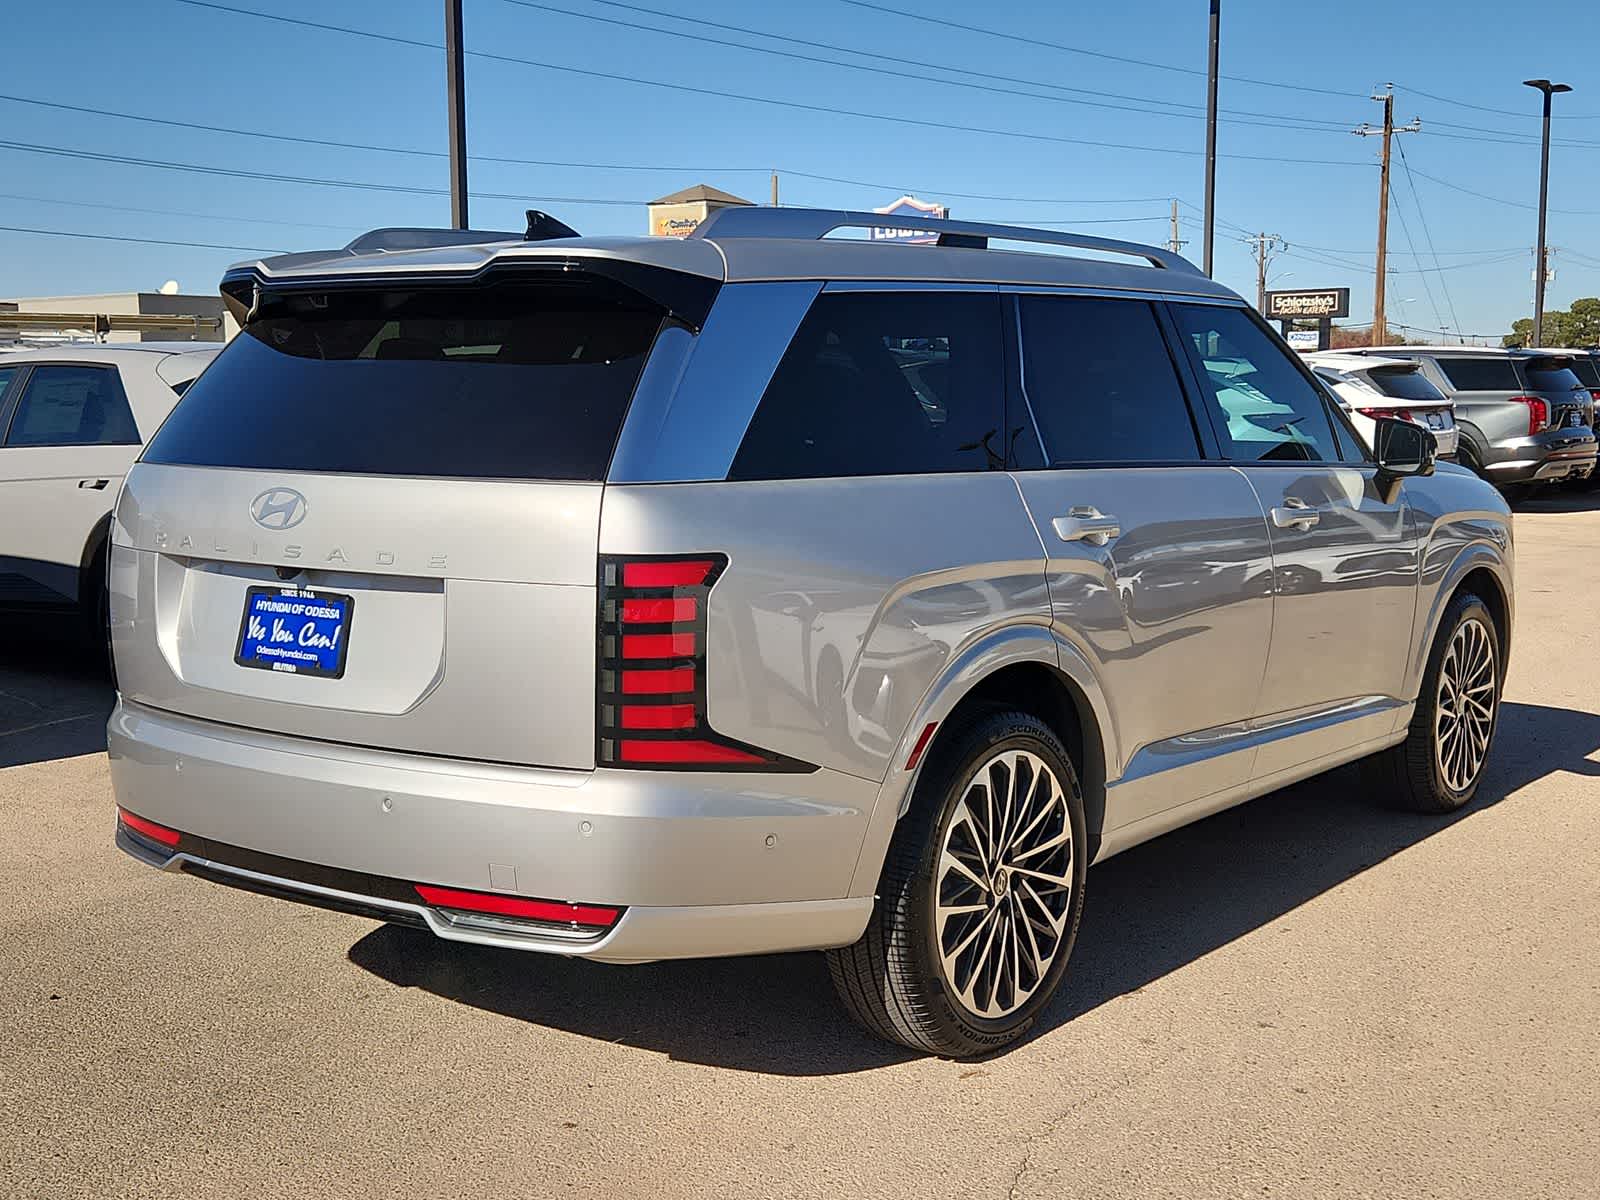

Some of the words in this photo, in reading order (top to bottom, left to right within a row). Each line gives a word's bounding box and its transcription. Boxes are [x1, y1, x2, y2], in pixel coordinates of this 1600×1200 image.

[155, 532, 448, 569] PALISADE
[256, 600, 291, 614] HYUNDAI
[292, 604, 305, 615] OF
[305, 606, 340, 619] ODESSA
[247, 615, 267, 640] Yes
[270, 618, 294, 642] You
[298, 621, 342, 650] Can!
